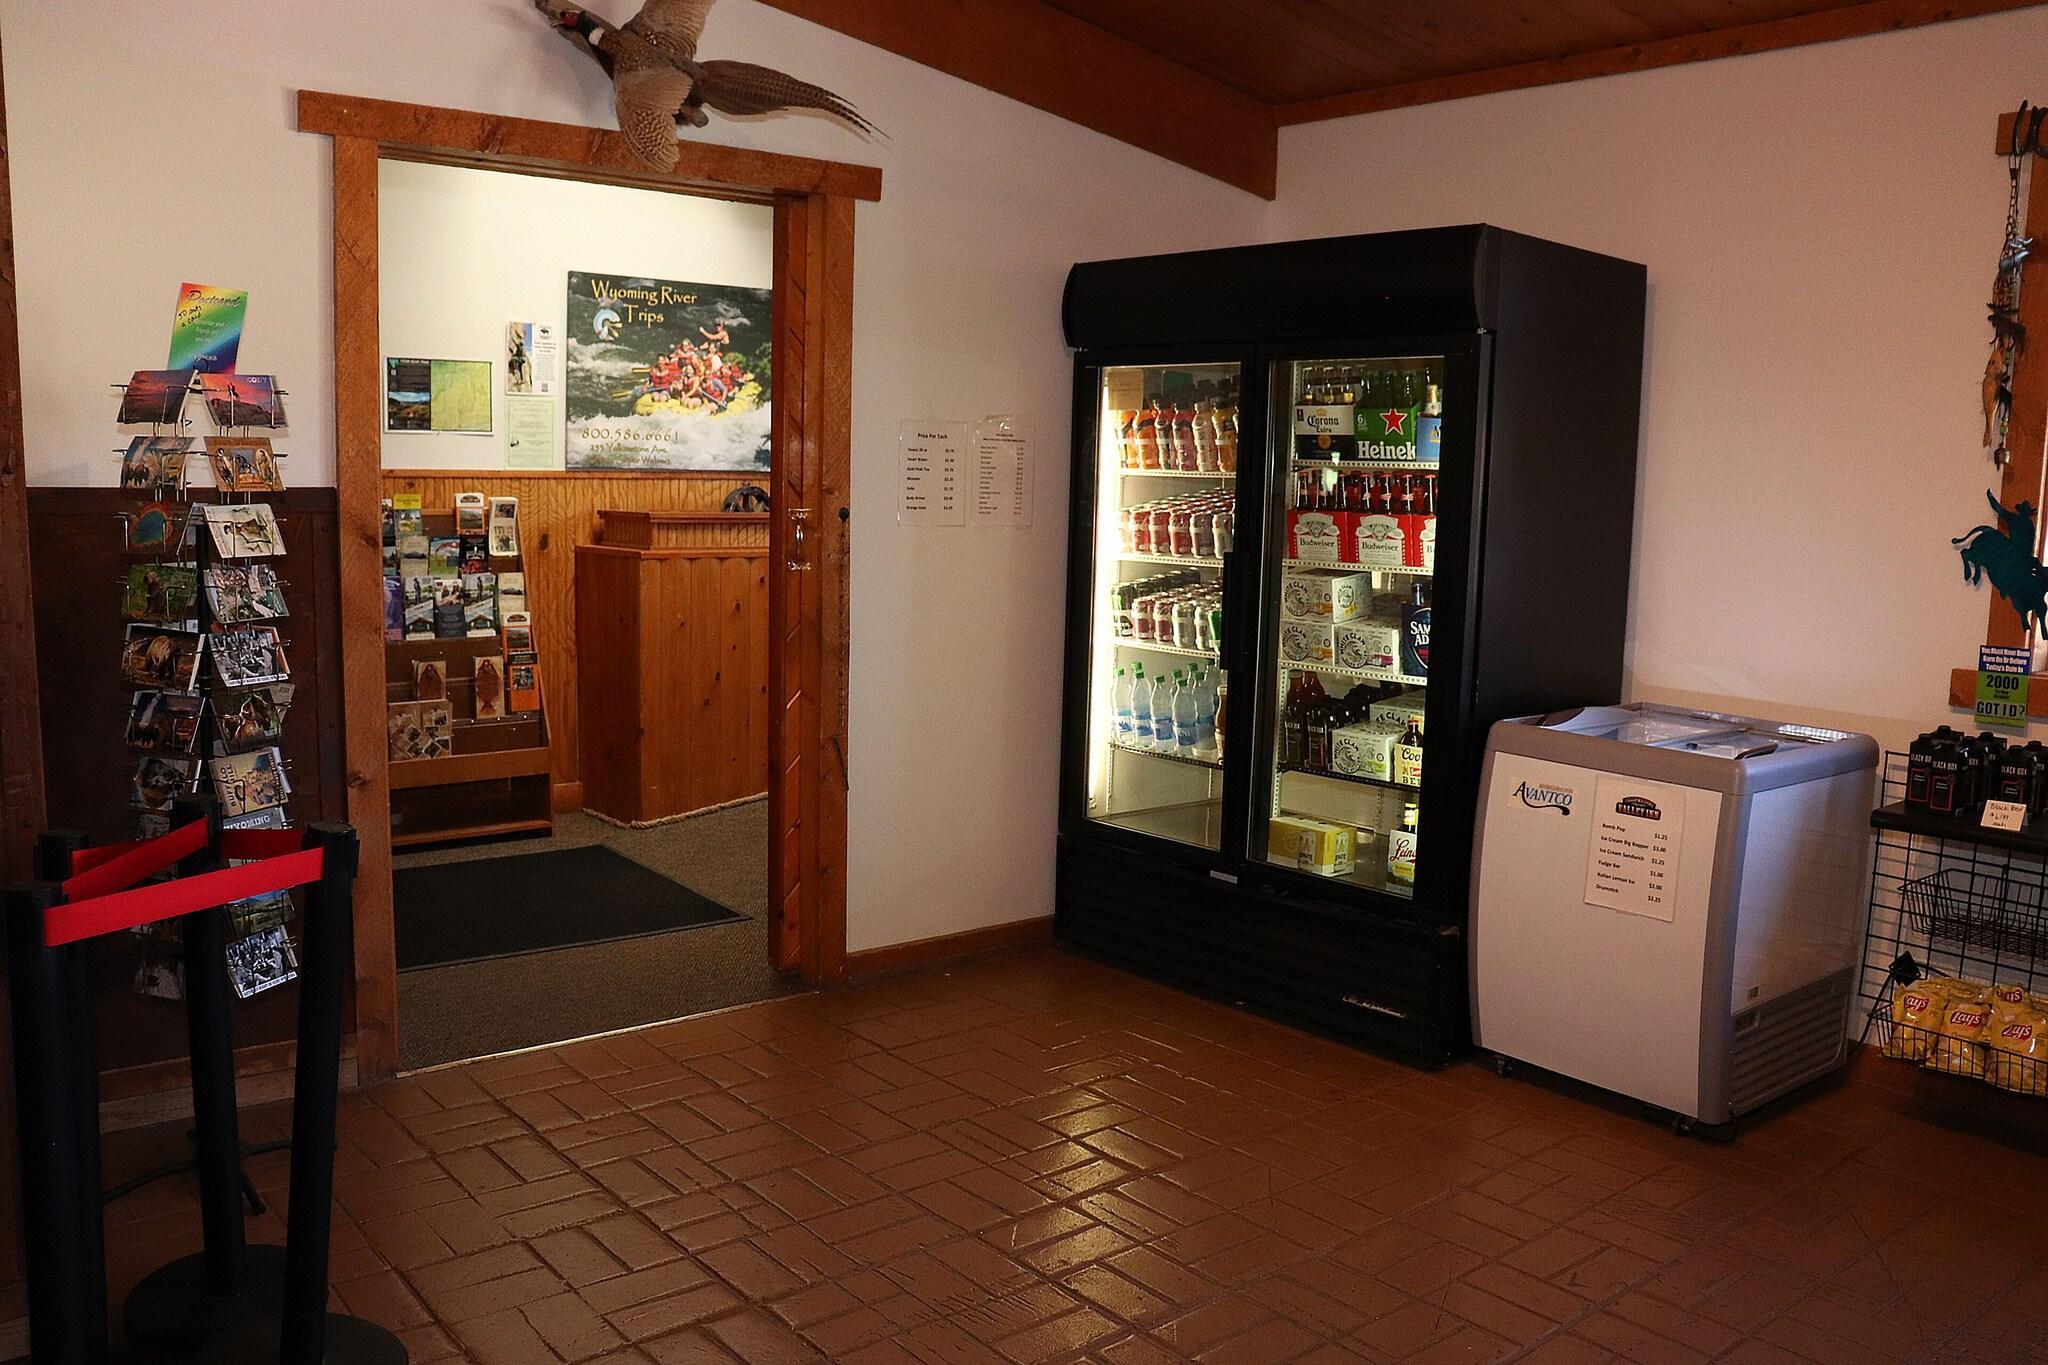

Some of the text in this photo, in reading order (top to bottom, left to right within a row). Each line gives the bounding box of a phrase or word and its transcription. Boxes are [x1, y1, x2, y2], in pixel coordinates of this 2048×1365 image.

[591, 279, 698, 306] Wyoming River
[623, 303, 665, 329] Trips
[1306, 414, 1340, 428] Corona
[1357, 440, 1417, 460] Heinek
[1299, 538, 1335, 548] Budweiser
[1361, 541, 1399, 552] Budweiser
[1986, 674, 2020, 691] 2000
[1976, 701, 2001, 716] GOT
[1947, 762, 1958, 771] BOX
[2016, 766, 2028, 776] BOX
[1512, 780, 1573, 811] AVANTCO
[1618, 803, 1645, 817] VALLEY
[1616, 825, 1626, 833] Pop
[1608, 836, 1624, 844] Cream
[1623, 839, 1632, 847] Big
[1606, 848, 1622, 857] Cream
[1622, 852, 1645, 861] Sandwich
[1598, 859, 1612, 868] Fudge
[1611, 874, 1628, 883] Lemon
[1595, 883, 1619, 894] Drumstick
[1904, 995, 1930, 1011] ays
